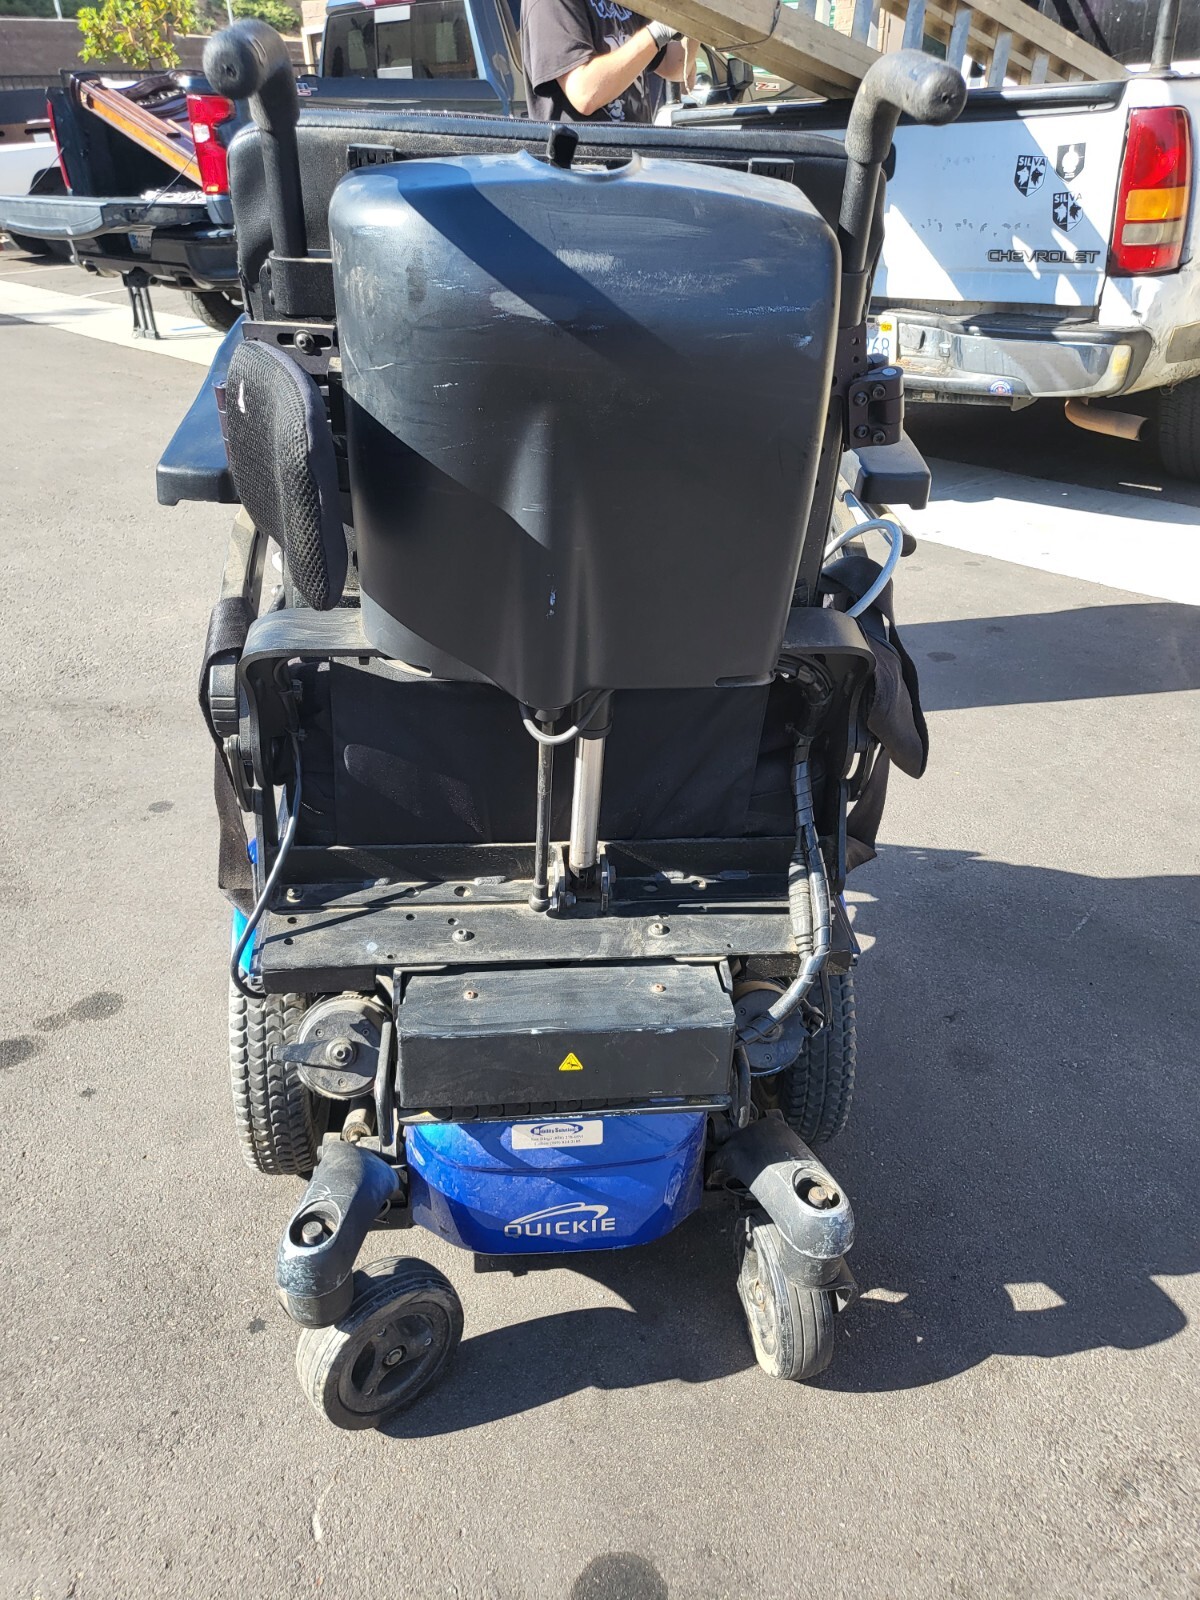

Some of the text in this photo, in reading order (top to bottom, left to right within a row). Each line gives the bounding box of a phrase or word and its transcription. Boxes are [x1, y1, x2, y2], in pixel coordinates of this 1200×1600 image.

[1018, 156, 1046, 167] SILVA
[1054, 193, 1083, 204] SILVA
[987, 249, 1101, 263] CHEVROLET
[504, 1217, 616, 1239] QUICKIE
